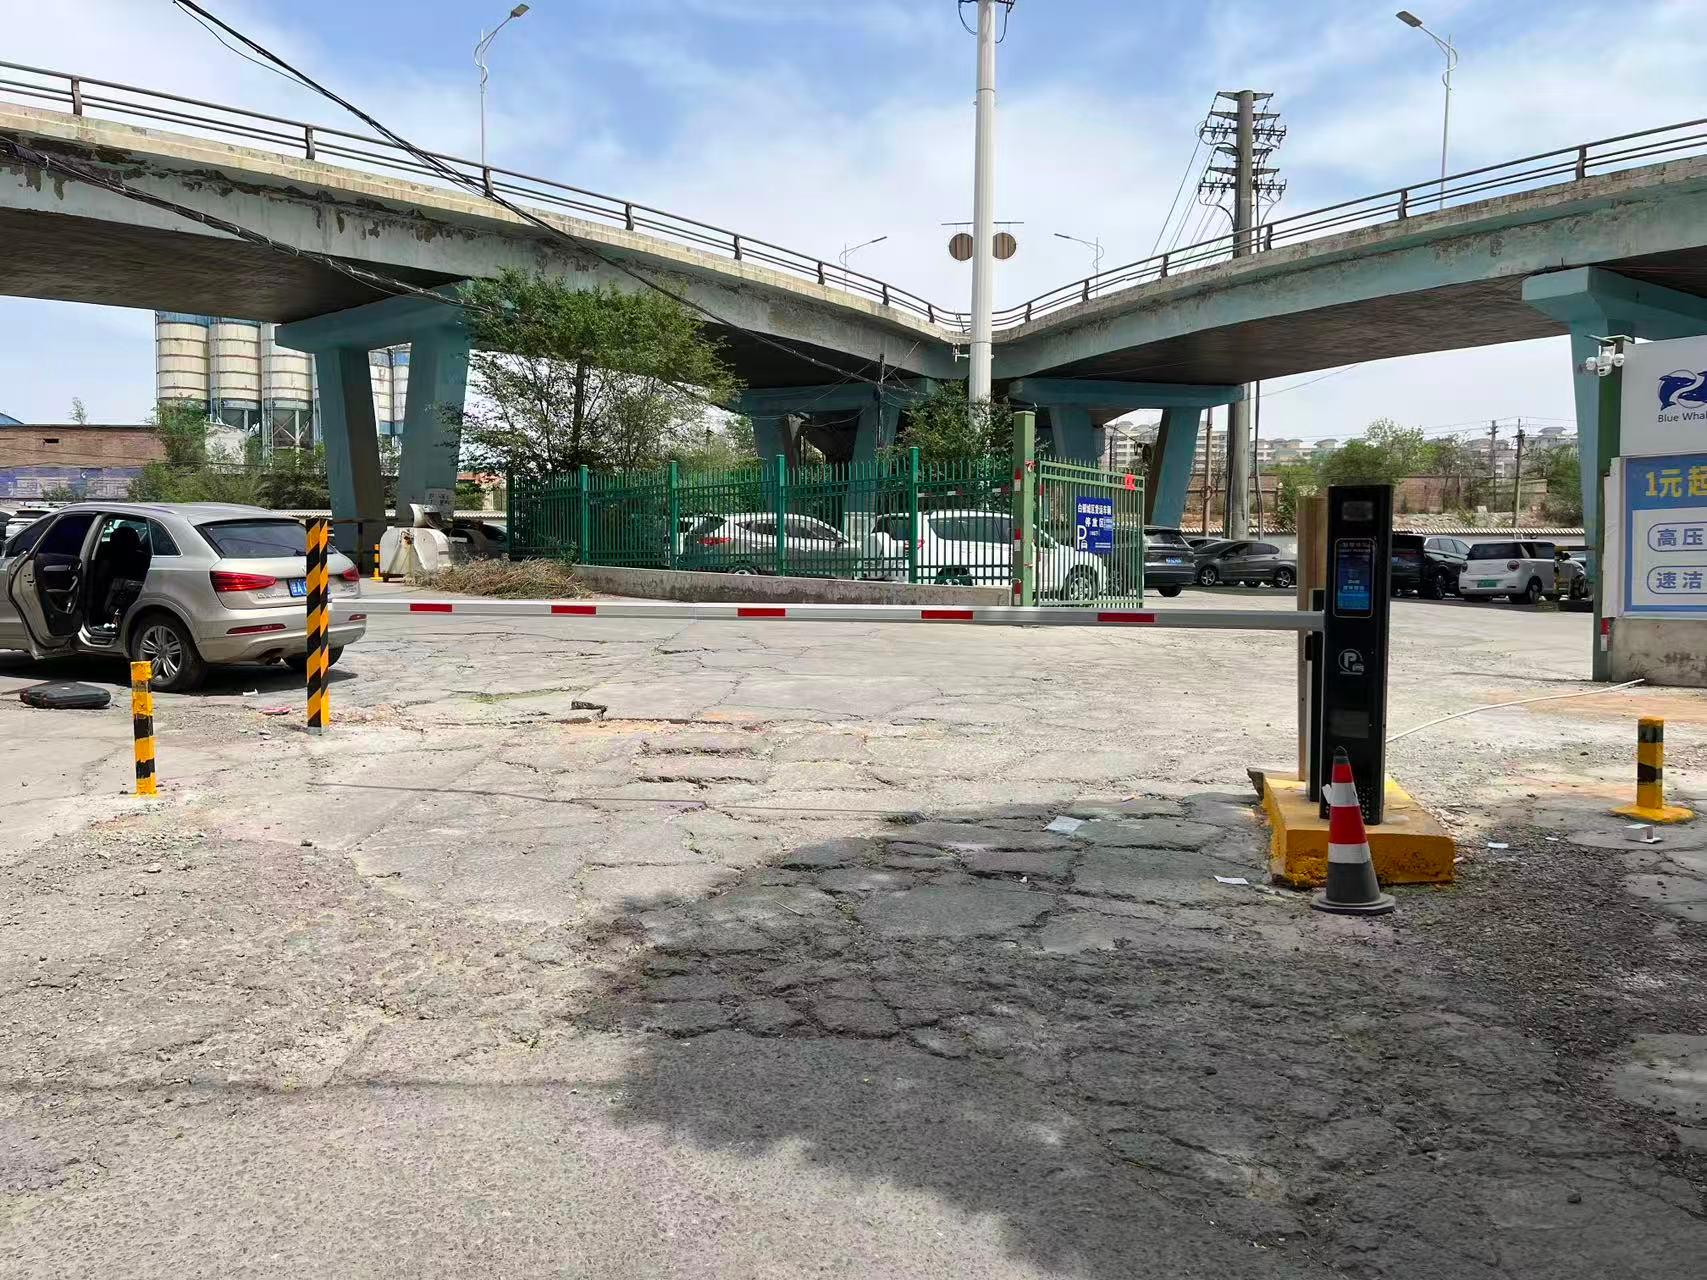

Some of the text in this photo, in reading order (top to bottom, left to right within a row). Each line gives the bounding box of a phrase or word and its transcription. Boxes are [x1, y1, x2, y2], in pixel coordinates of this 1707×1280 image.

[1657, 414, 1680, 423] Blue
[1656, 528, 1704, 547] 高压
[1656, 571, 1703, 590] 速洁
